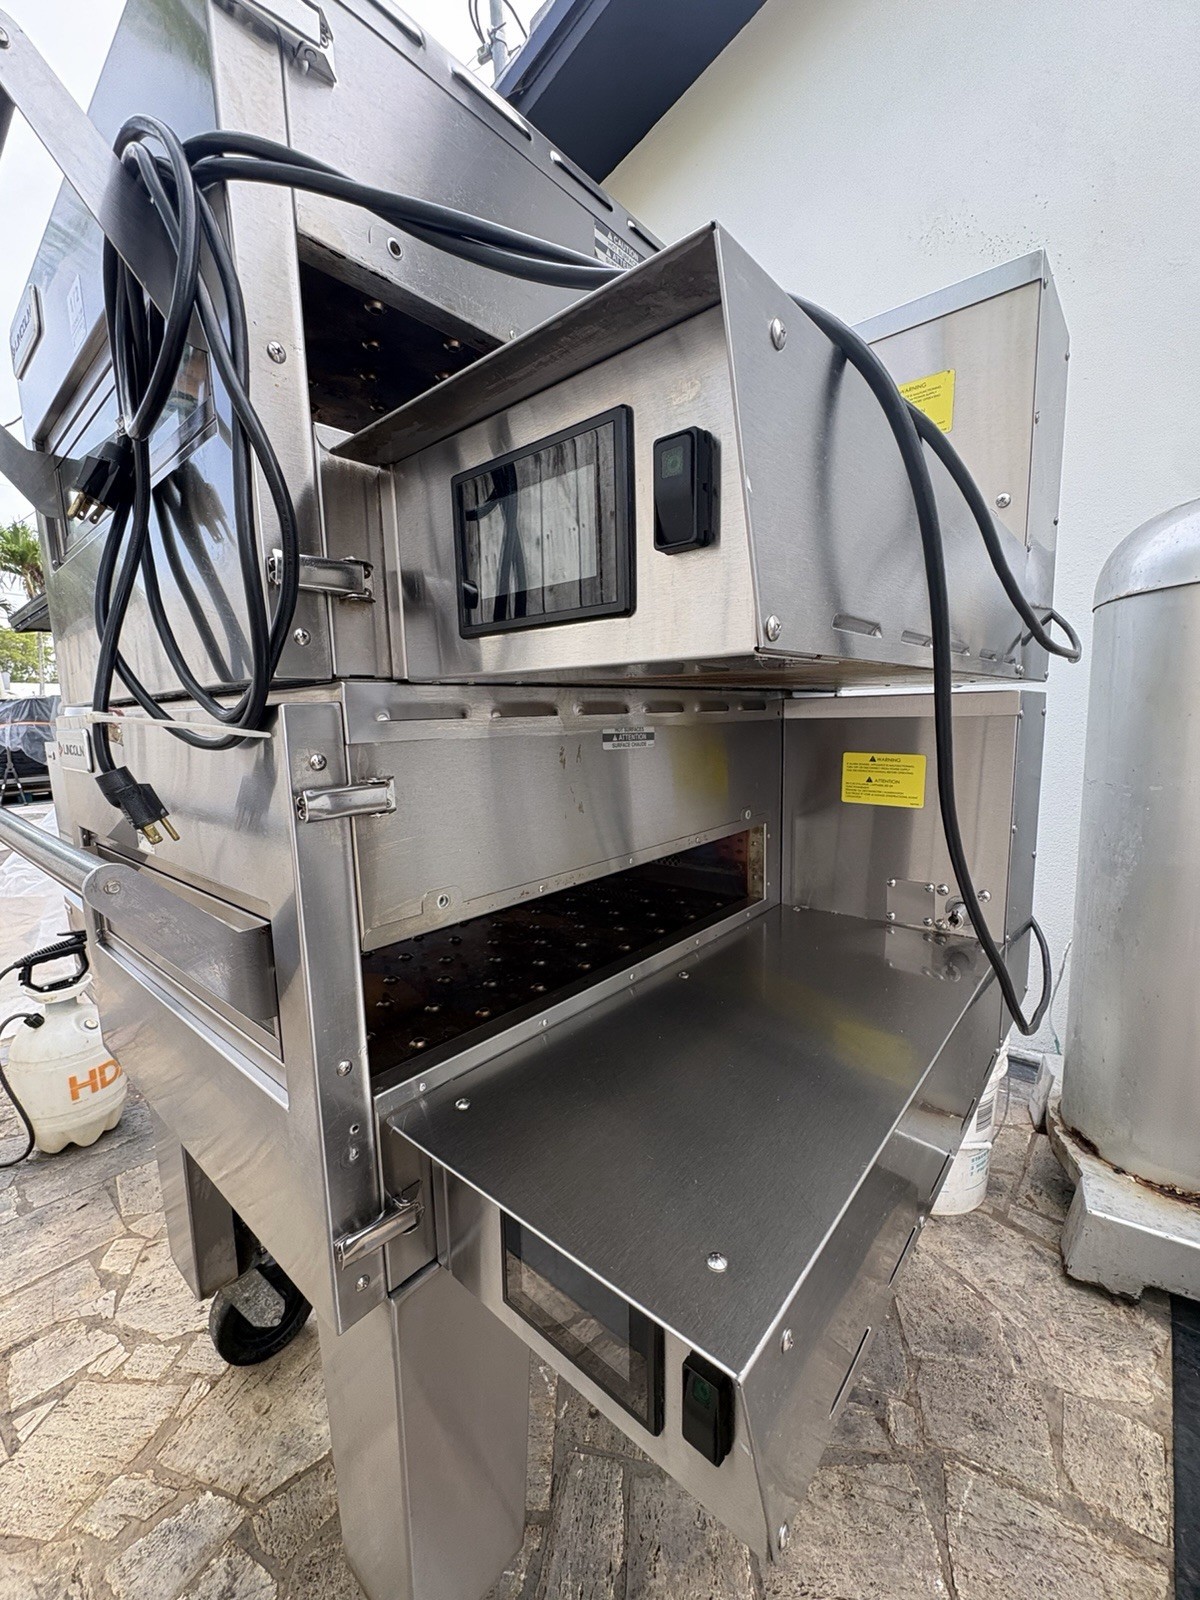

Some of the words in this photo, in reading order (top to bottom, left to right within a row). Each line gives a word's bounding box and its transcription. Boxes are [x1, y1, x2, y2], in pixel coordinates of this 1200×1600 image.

[613, 235, 639, 261] CAUTION
[64, 744, 85, 757] LINCOLN
[69, 1059, 123, 1101] HD
